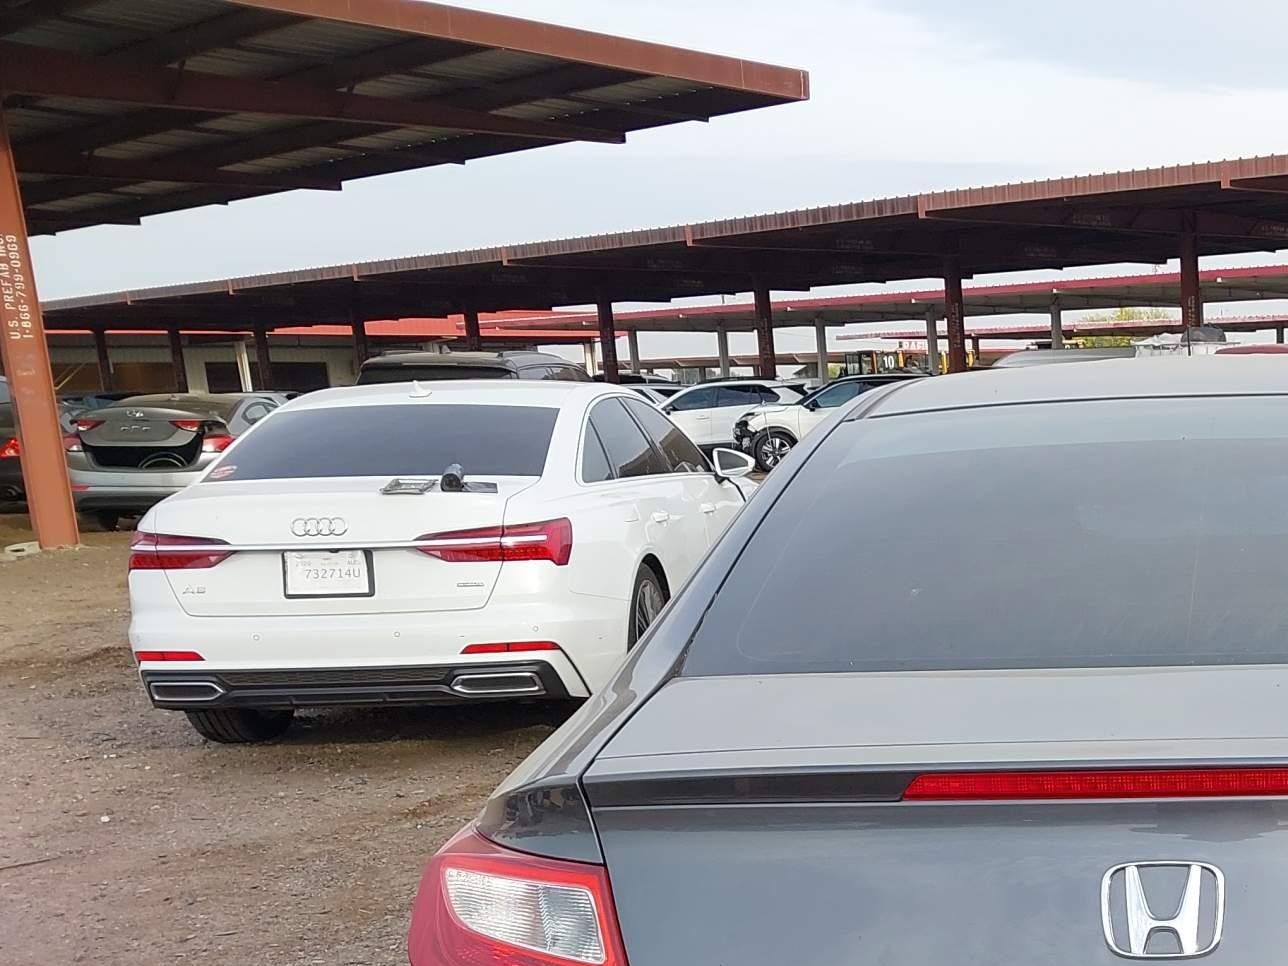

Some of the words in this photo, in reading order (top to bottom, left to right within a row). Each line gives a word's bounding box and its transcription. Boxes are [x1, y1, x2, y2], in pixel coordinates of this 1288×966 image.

[6, 234, 34, 338] 1-866-799-0969
[8, 316, 22, 339] U.S.
[304, 567, 361, 579] 732714U
